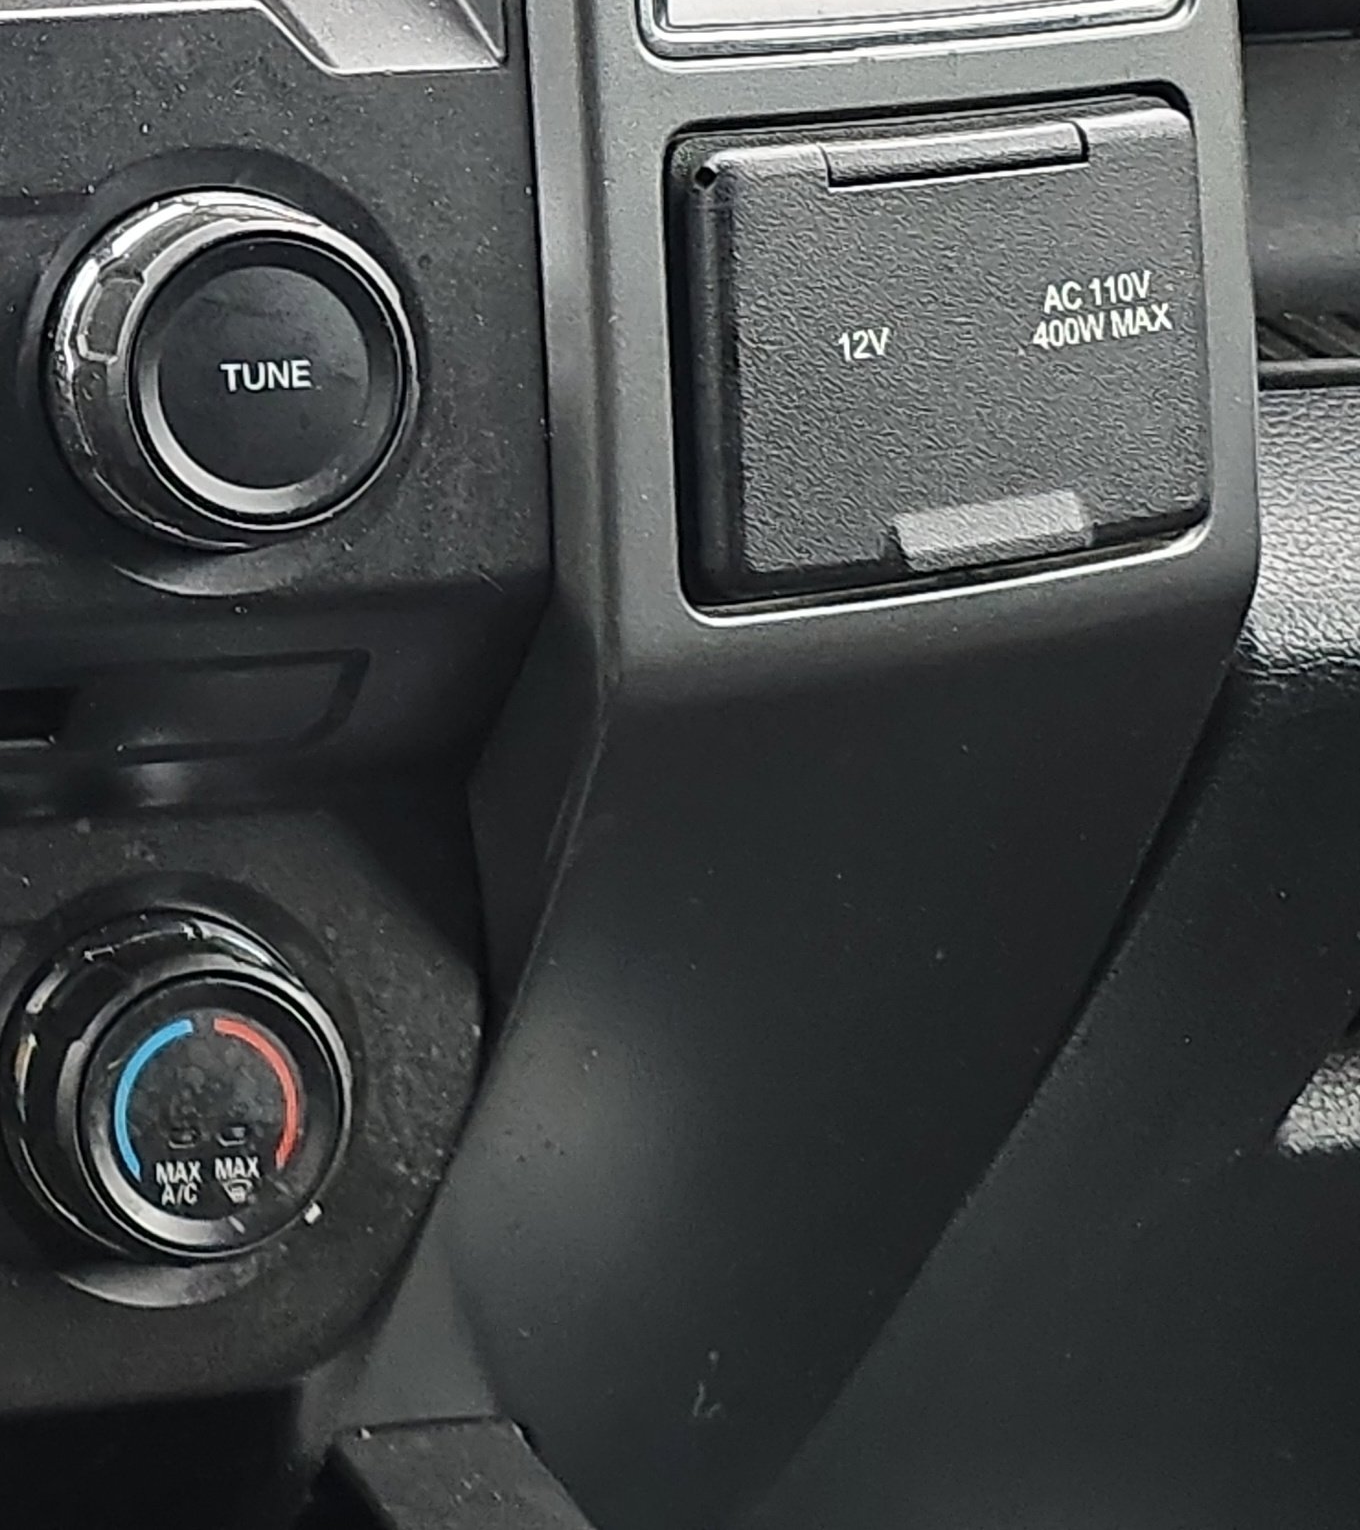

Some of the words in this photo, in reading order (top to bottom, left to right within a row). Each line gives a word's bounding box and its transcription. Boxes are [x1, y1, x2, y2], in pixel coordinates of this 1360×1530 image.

[1043, 282, 1083, 314] AC
[1088, 269, 1153, 306] 110V
[1031, 311, 1105, 350] 400W
[1110, 302, 1173, 339] MAX
[837, 326, 890, 362] 12V
[220, 359, 312, 392] TUNE
[155, 1160, 203, 1185] MAX
[214, 1155, 261, 1181] MAX
[160, 1181, 199, 1207] A/C
